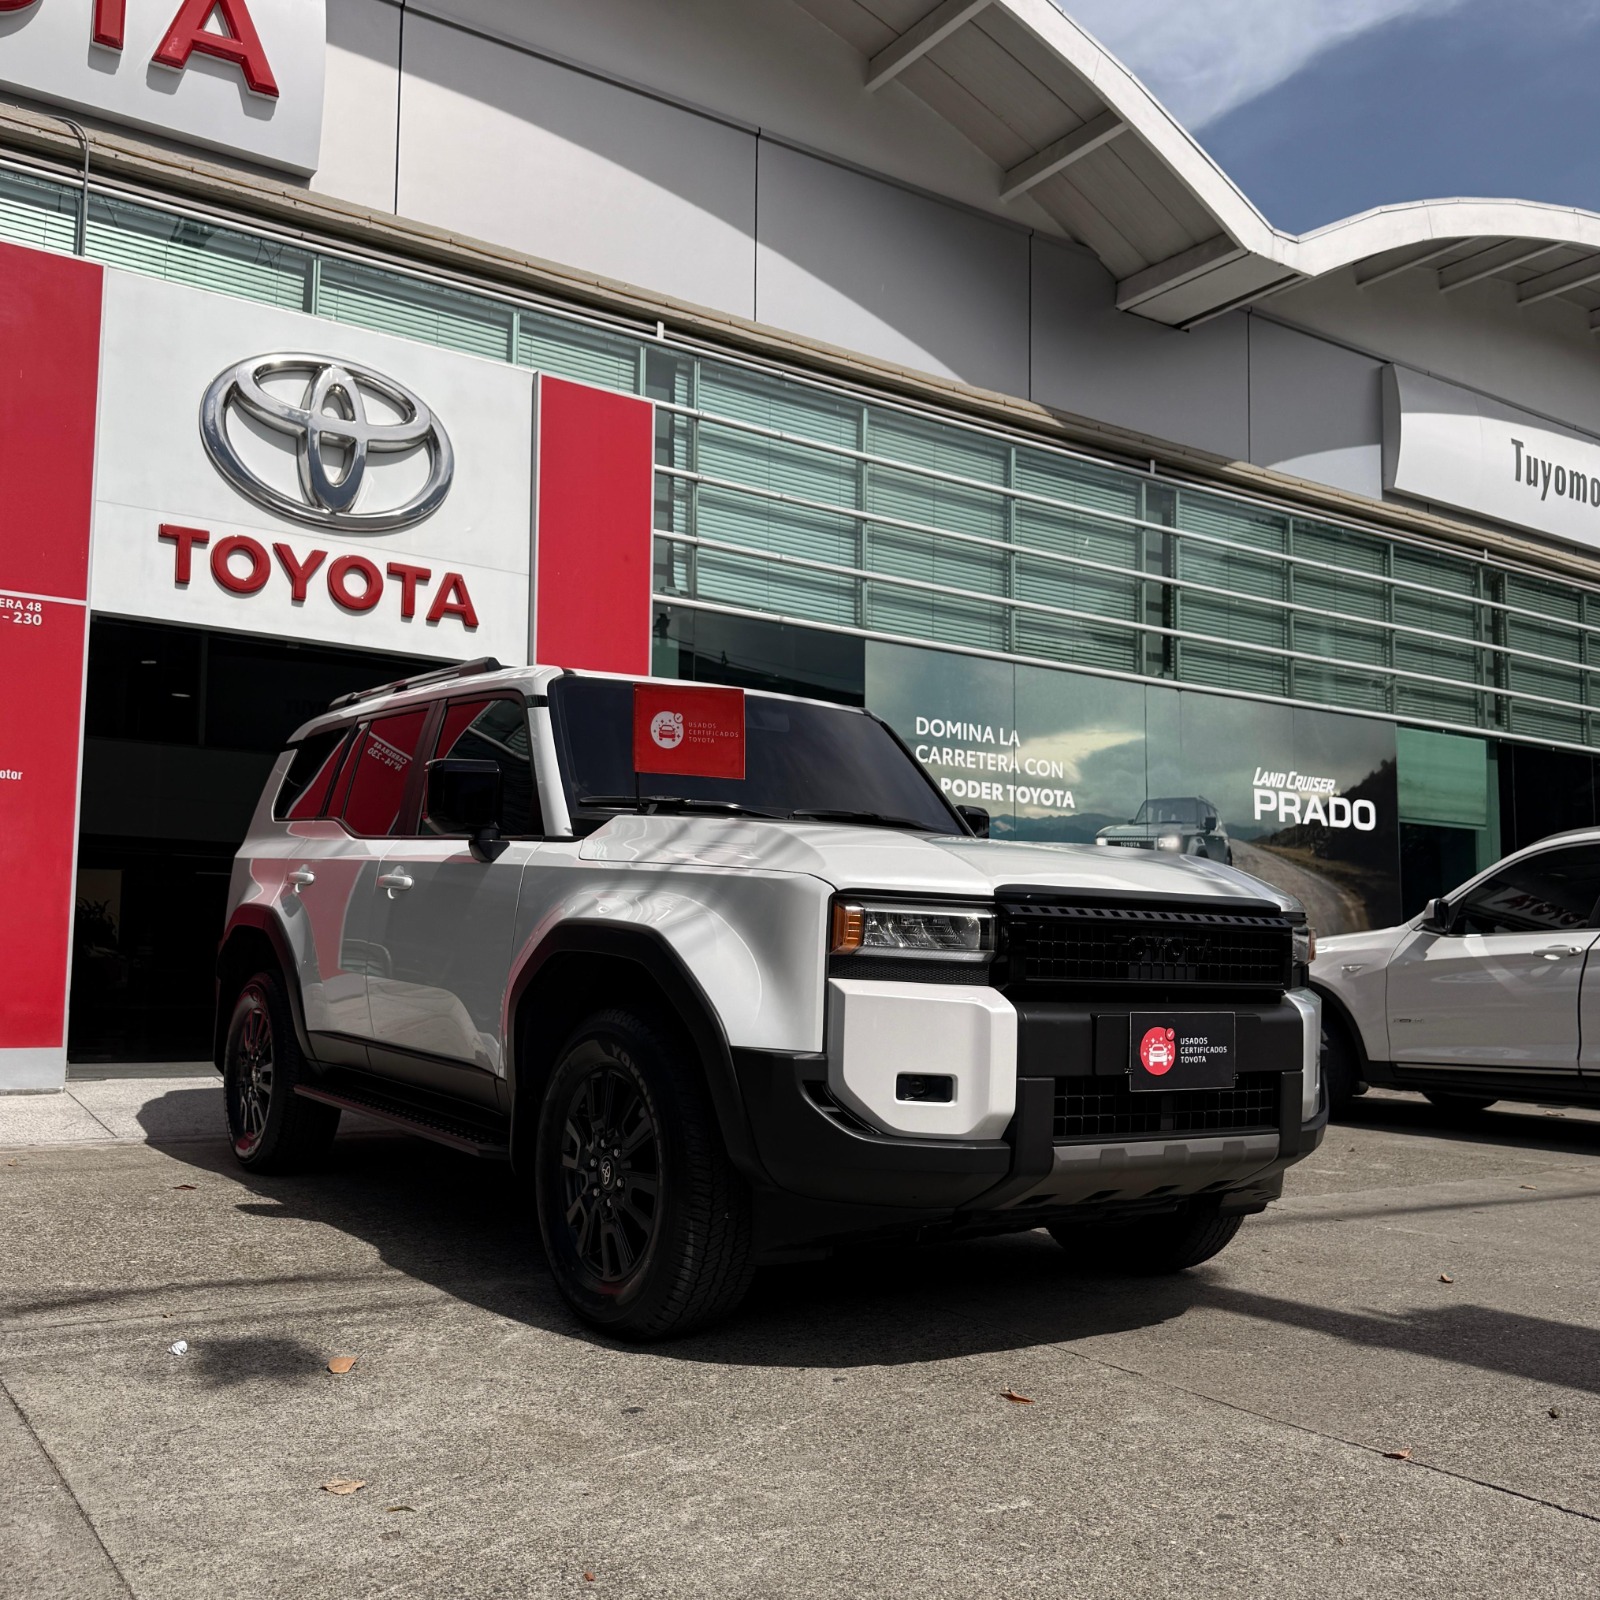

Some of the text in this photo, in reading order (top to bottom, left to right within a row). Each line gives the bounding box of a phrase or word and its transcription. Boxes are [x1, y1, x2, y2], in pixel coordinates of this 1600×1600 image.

[1510, 437, 1600, 508] Tuyomo
[158, 523, 479, 628] TOYOTA
[13, 611, 42, 626] 230
[26, 601, 42, 612] 48
[915, 716, 1021, 748] DOMINA LA
[915, 744, 1064, 779] CARRETERA CON
[940, 777, 1076, 808] PODER TOYOTA
[1252, 766, 1336, 795] LAND CRUISER
[1253, 788, 1376, 831] PRADO
[1180, 1037, 1208, 1045] USADOS
[1180, 1046, 1228, 1054] CERTIFICADOS
[1180, 1055, 1207, 1064] TOYOTA
